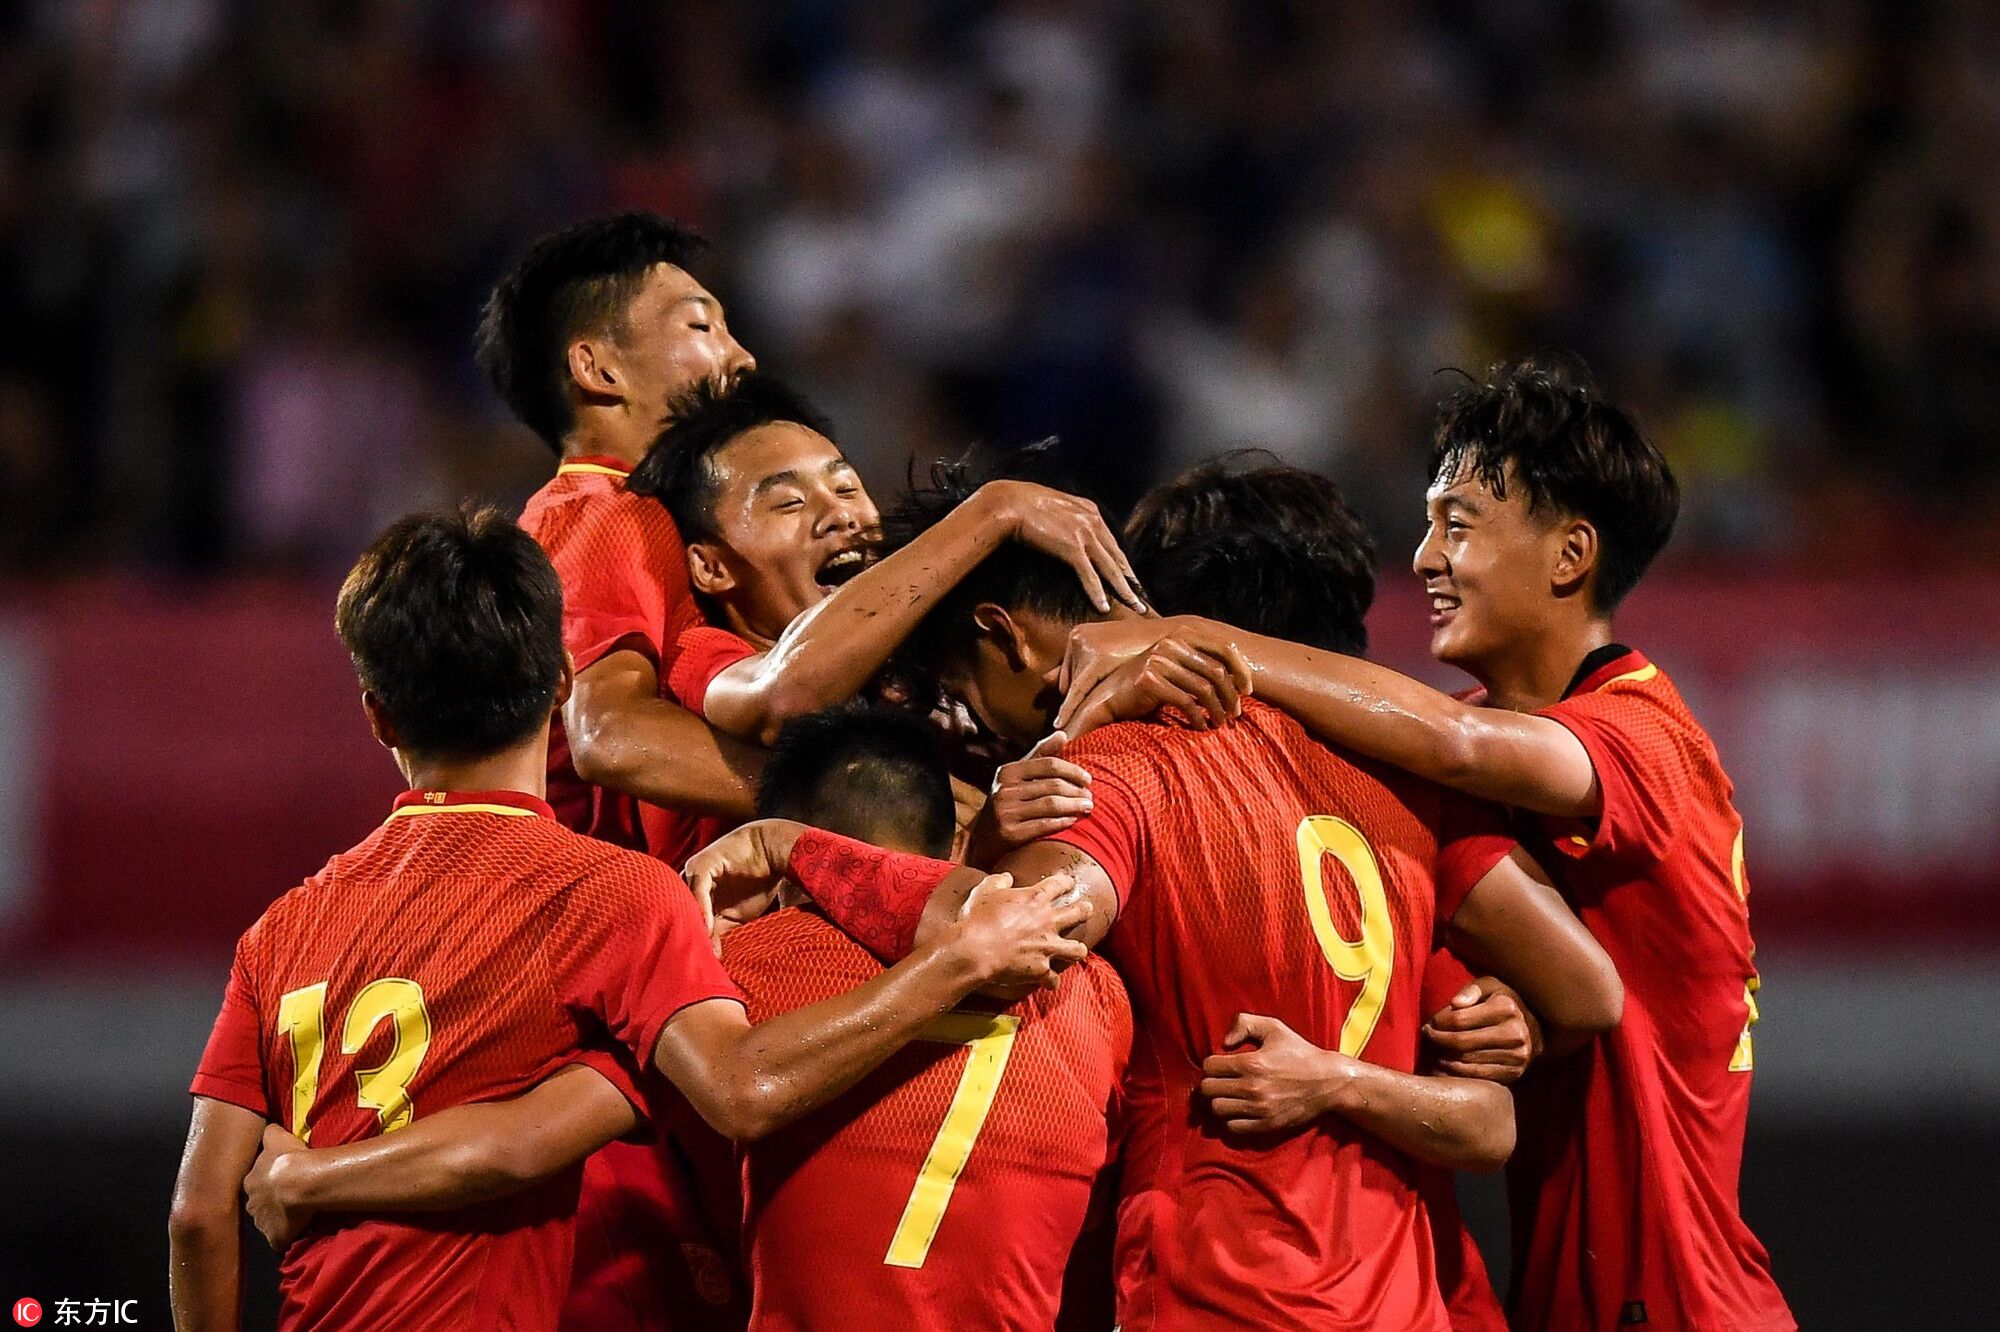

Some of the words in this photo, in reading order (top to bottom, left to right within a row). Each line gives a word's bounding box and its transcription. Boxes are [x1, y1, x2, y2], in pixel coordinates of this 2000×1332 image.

[423, 791, 447, 804] 中国
[1296, 815, 1394, 1059] 9
[278, 977, 431, 1147] 13
[883, 1011, 1021, 1269] 7
